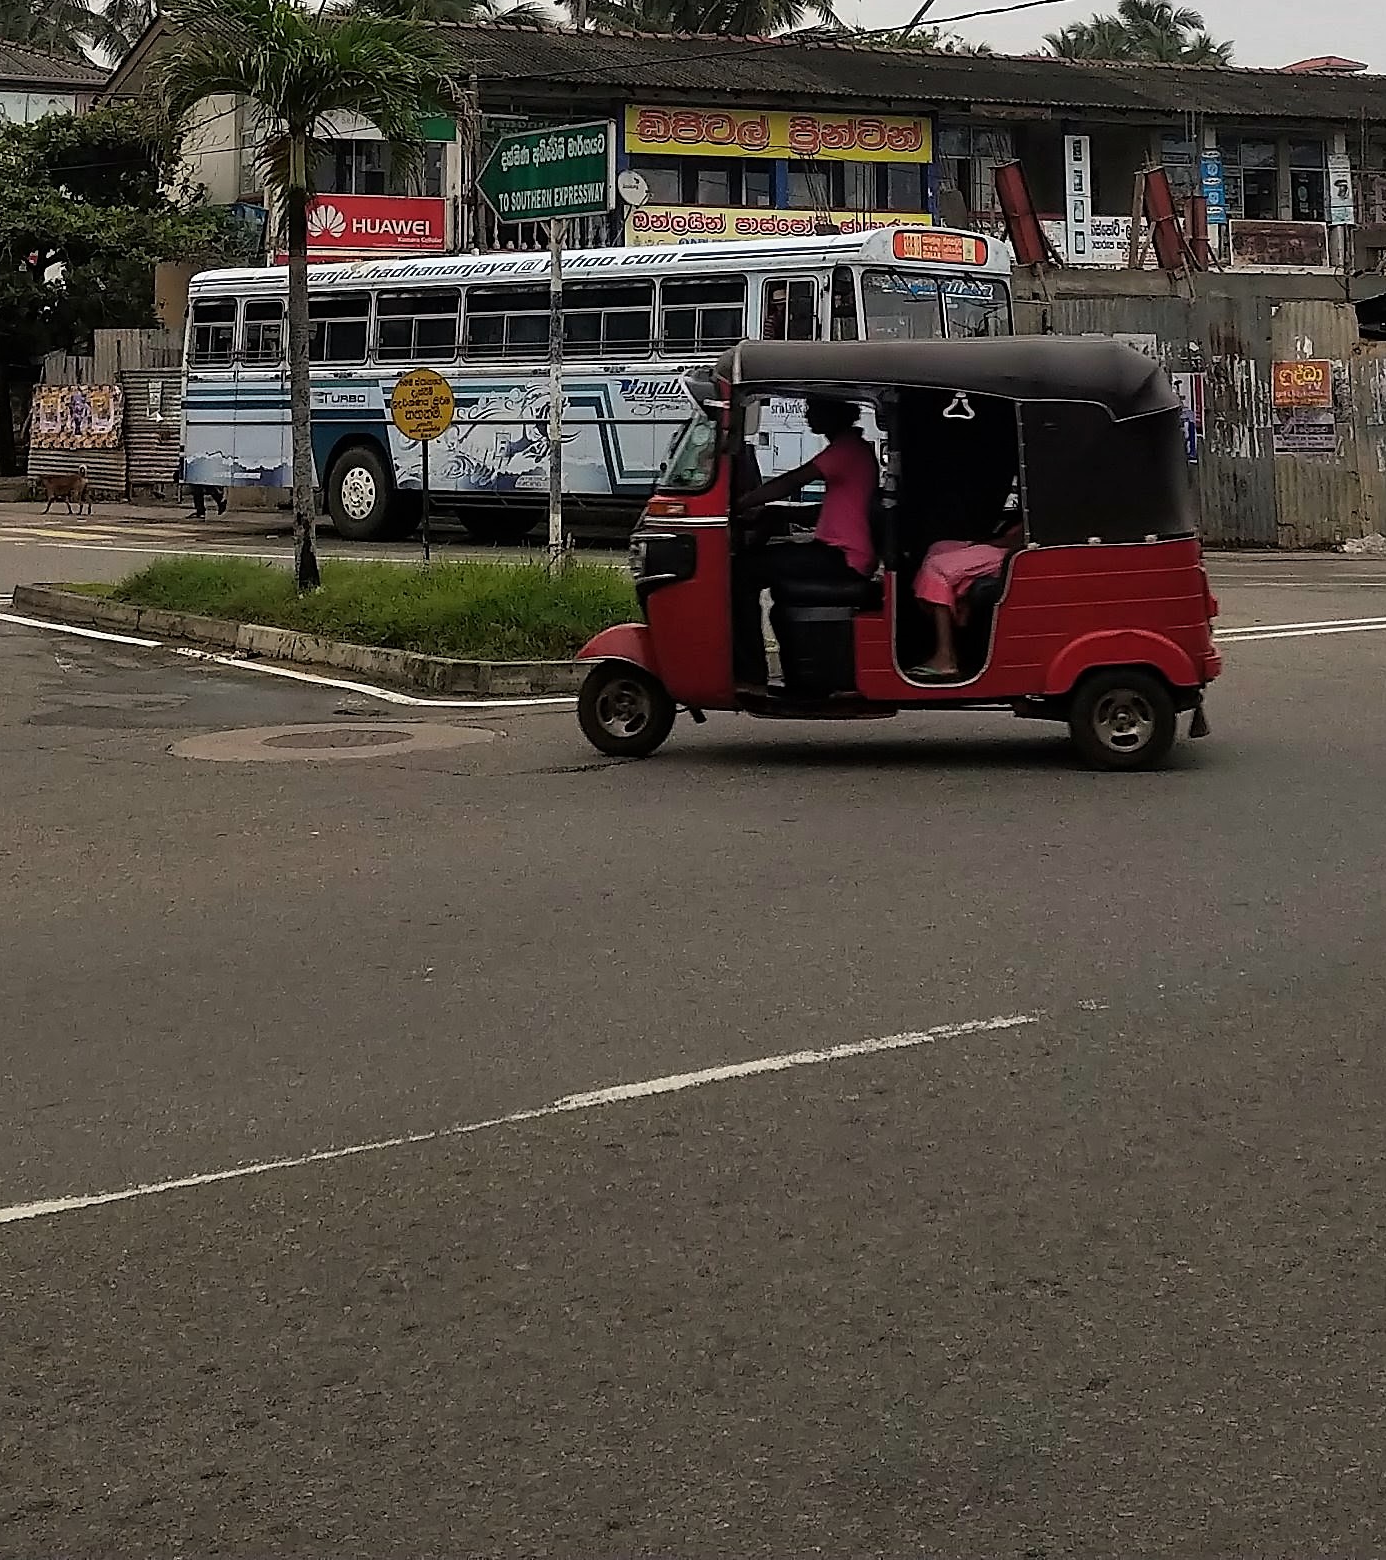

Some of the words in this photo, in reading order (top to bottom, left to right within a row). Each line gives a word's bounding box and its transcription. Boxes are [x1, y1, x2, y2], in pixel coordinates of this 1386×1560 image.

[498, 193, 510, 213] TO
[510, 188, 553, 211] SOUTHERN
[553, 181, 605, 208] EXPRESSWAY
[352, 218, 430, 236] HUAWEI
[734, 214, 818, 236] පාස්පෝ
[322, 391, 366, 405] TURBO
